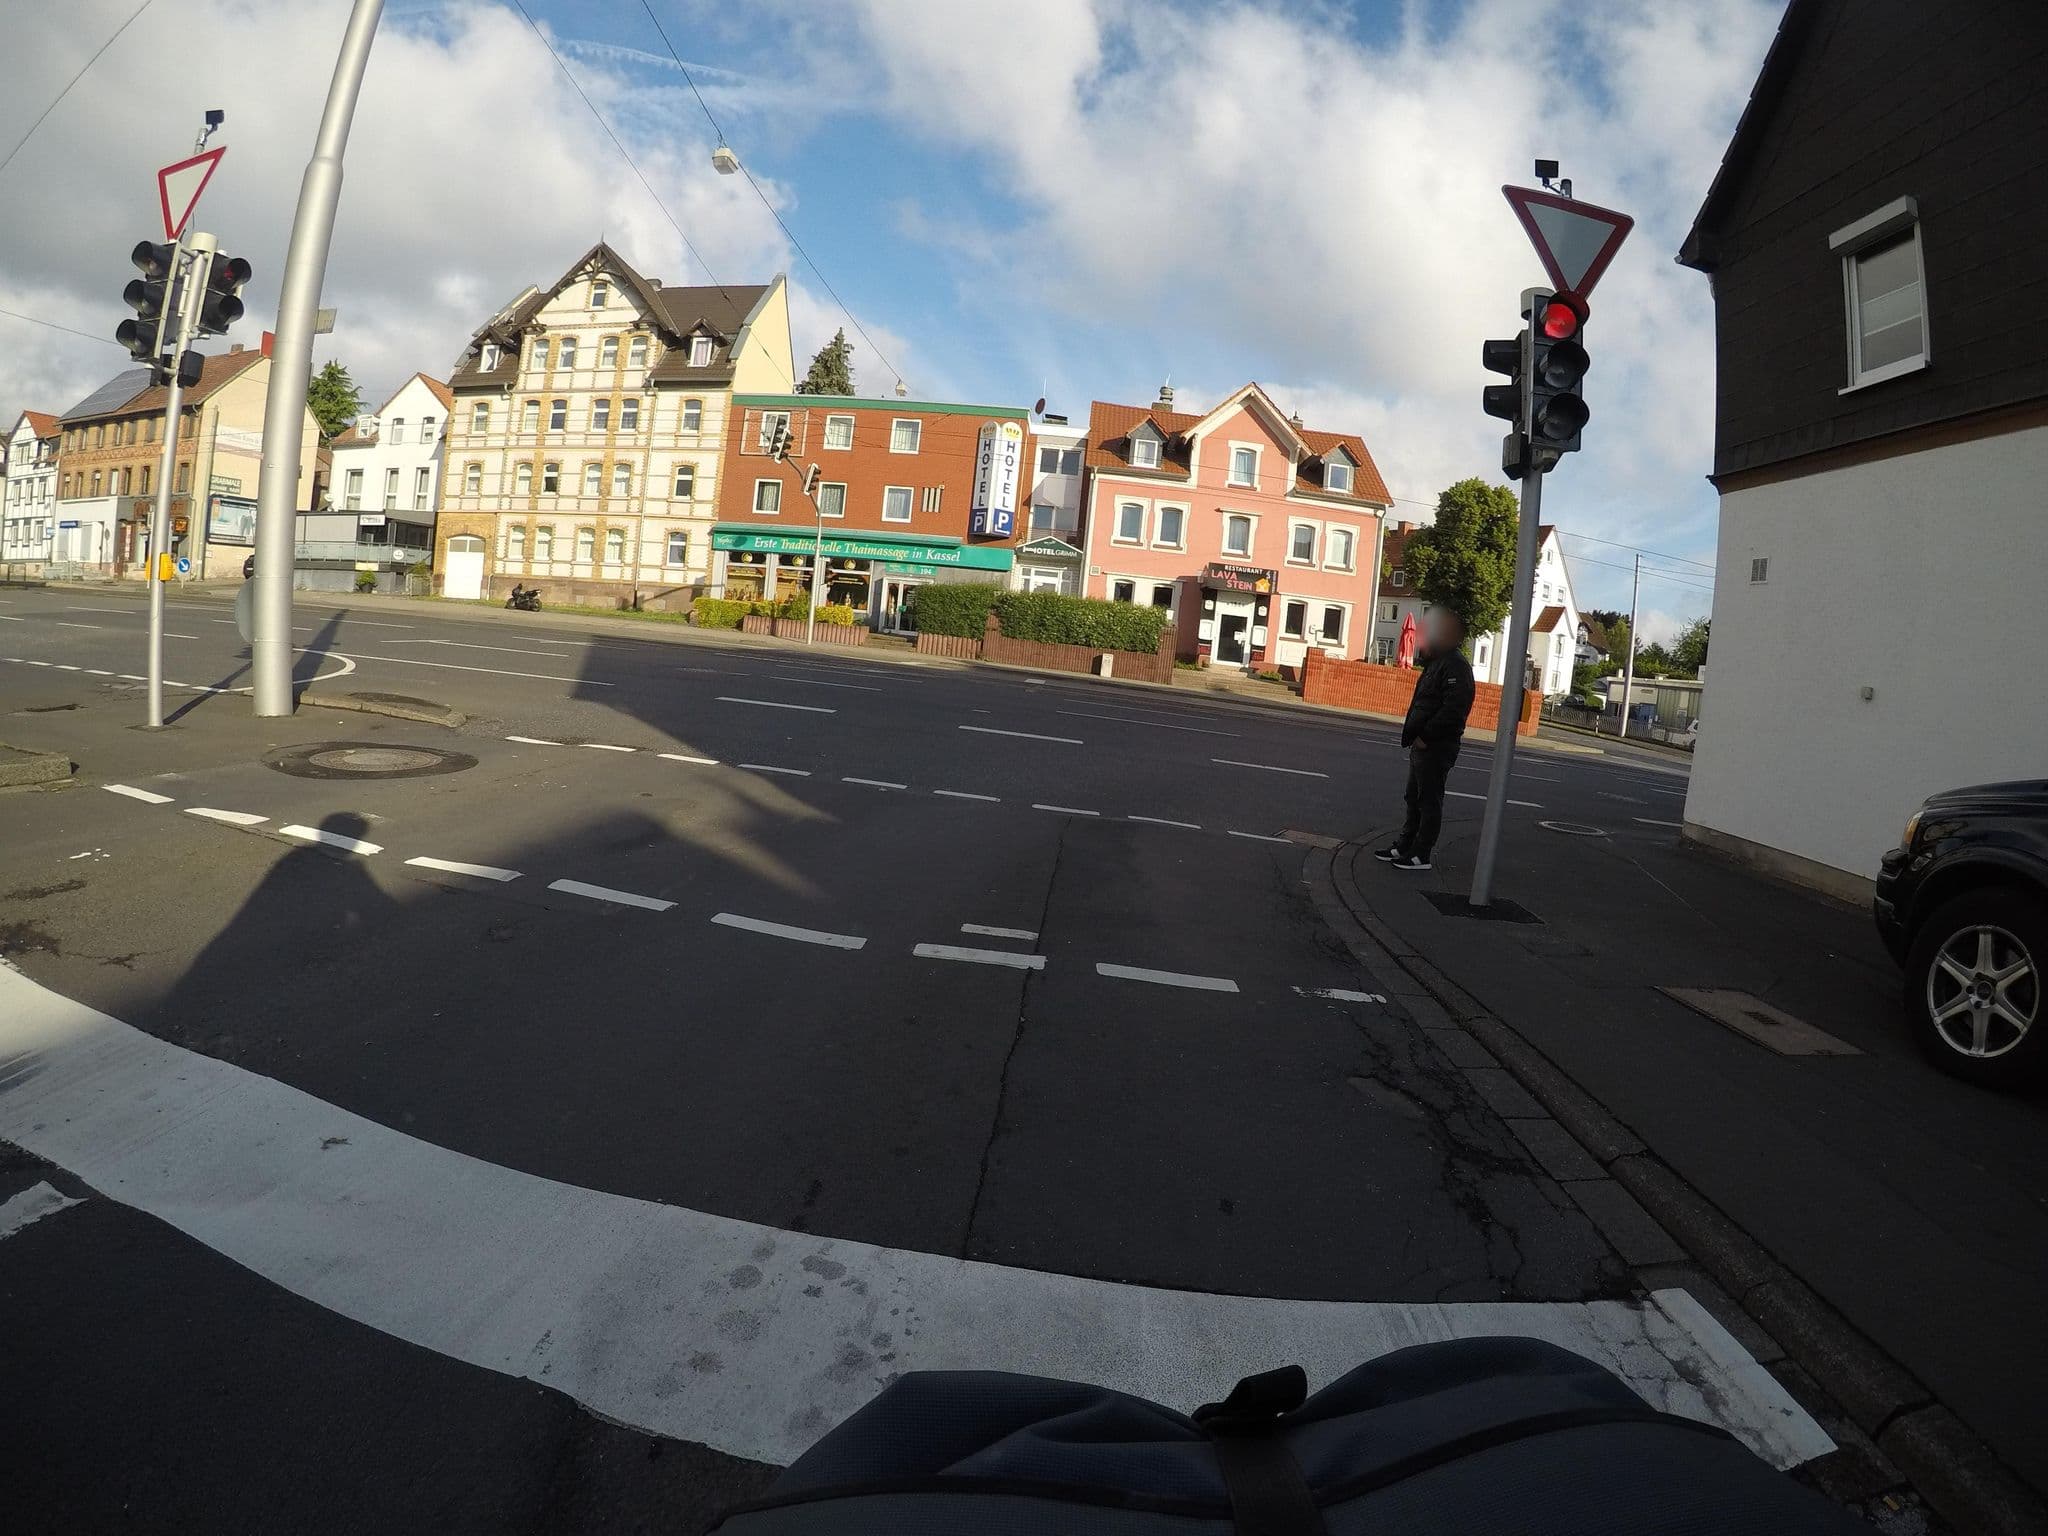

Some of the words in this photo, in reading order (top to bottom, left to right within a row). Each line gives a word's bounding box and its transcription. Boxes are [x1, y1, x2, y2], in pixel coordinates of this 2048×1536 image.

[978, 440, 991, 507] HOTEL
[1002, 441, 1016, 509] HOTEL
[998, 512, 1009, 528] P
[754, 537, 778, 549] Erste
[844, 544, 909, 560] Thaimassage
[912, 547, 923, 559] in
[926, 548, 961, 562] Kassel
[1211, 569, 1238, 580] LAVA
[1224, 565, 1264, 575] RESTAURANT
[1226, 580, 1253, 591] STEIN
